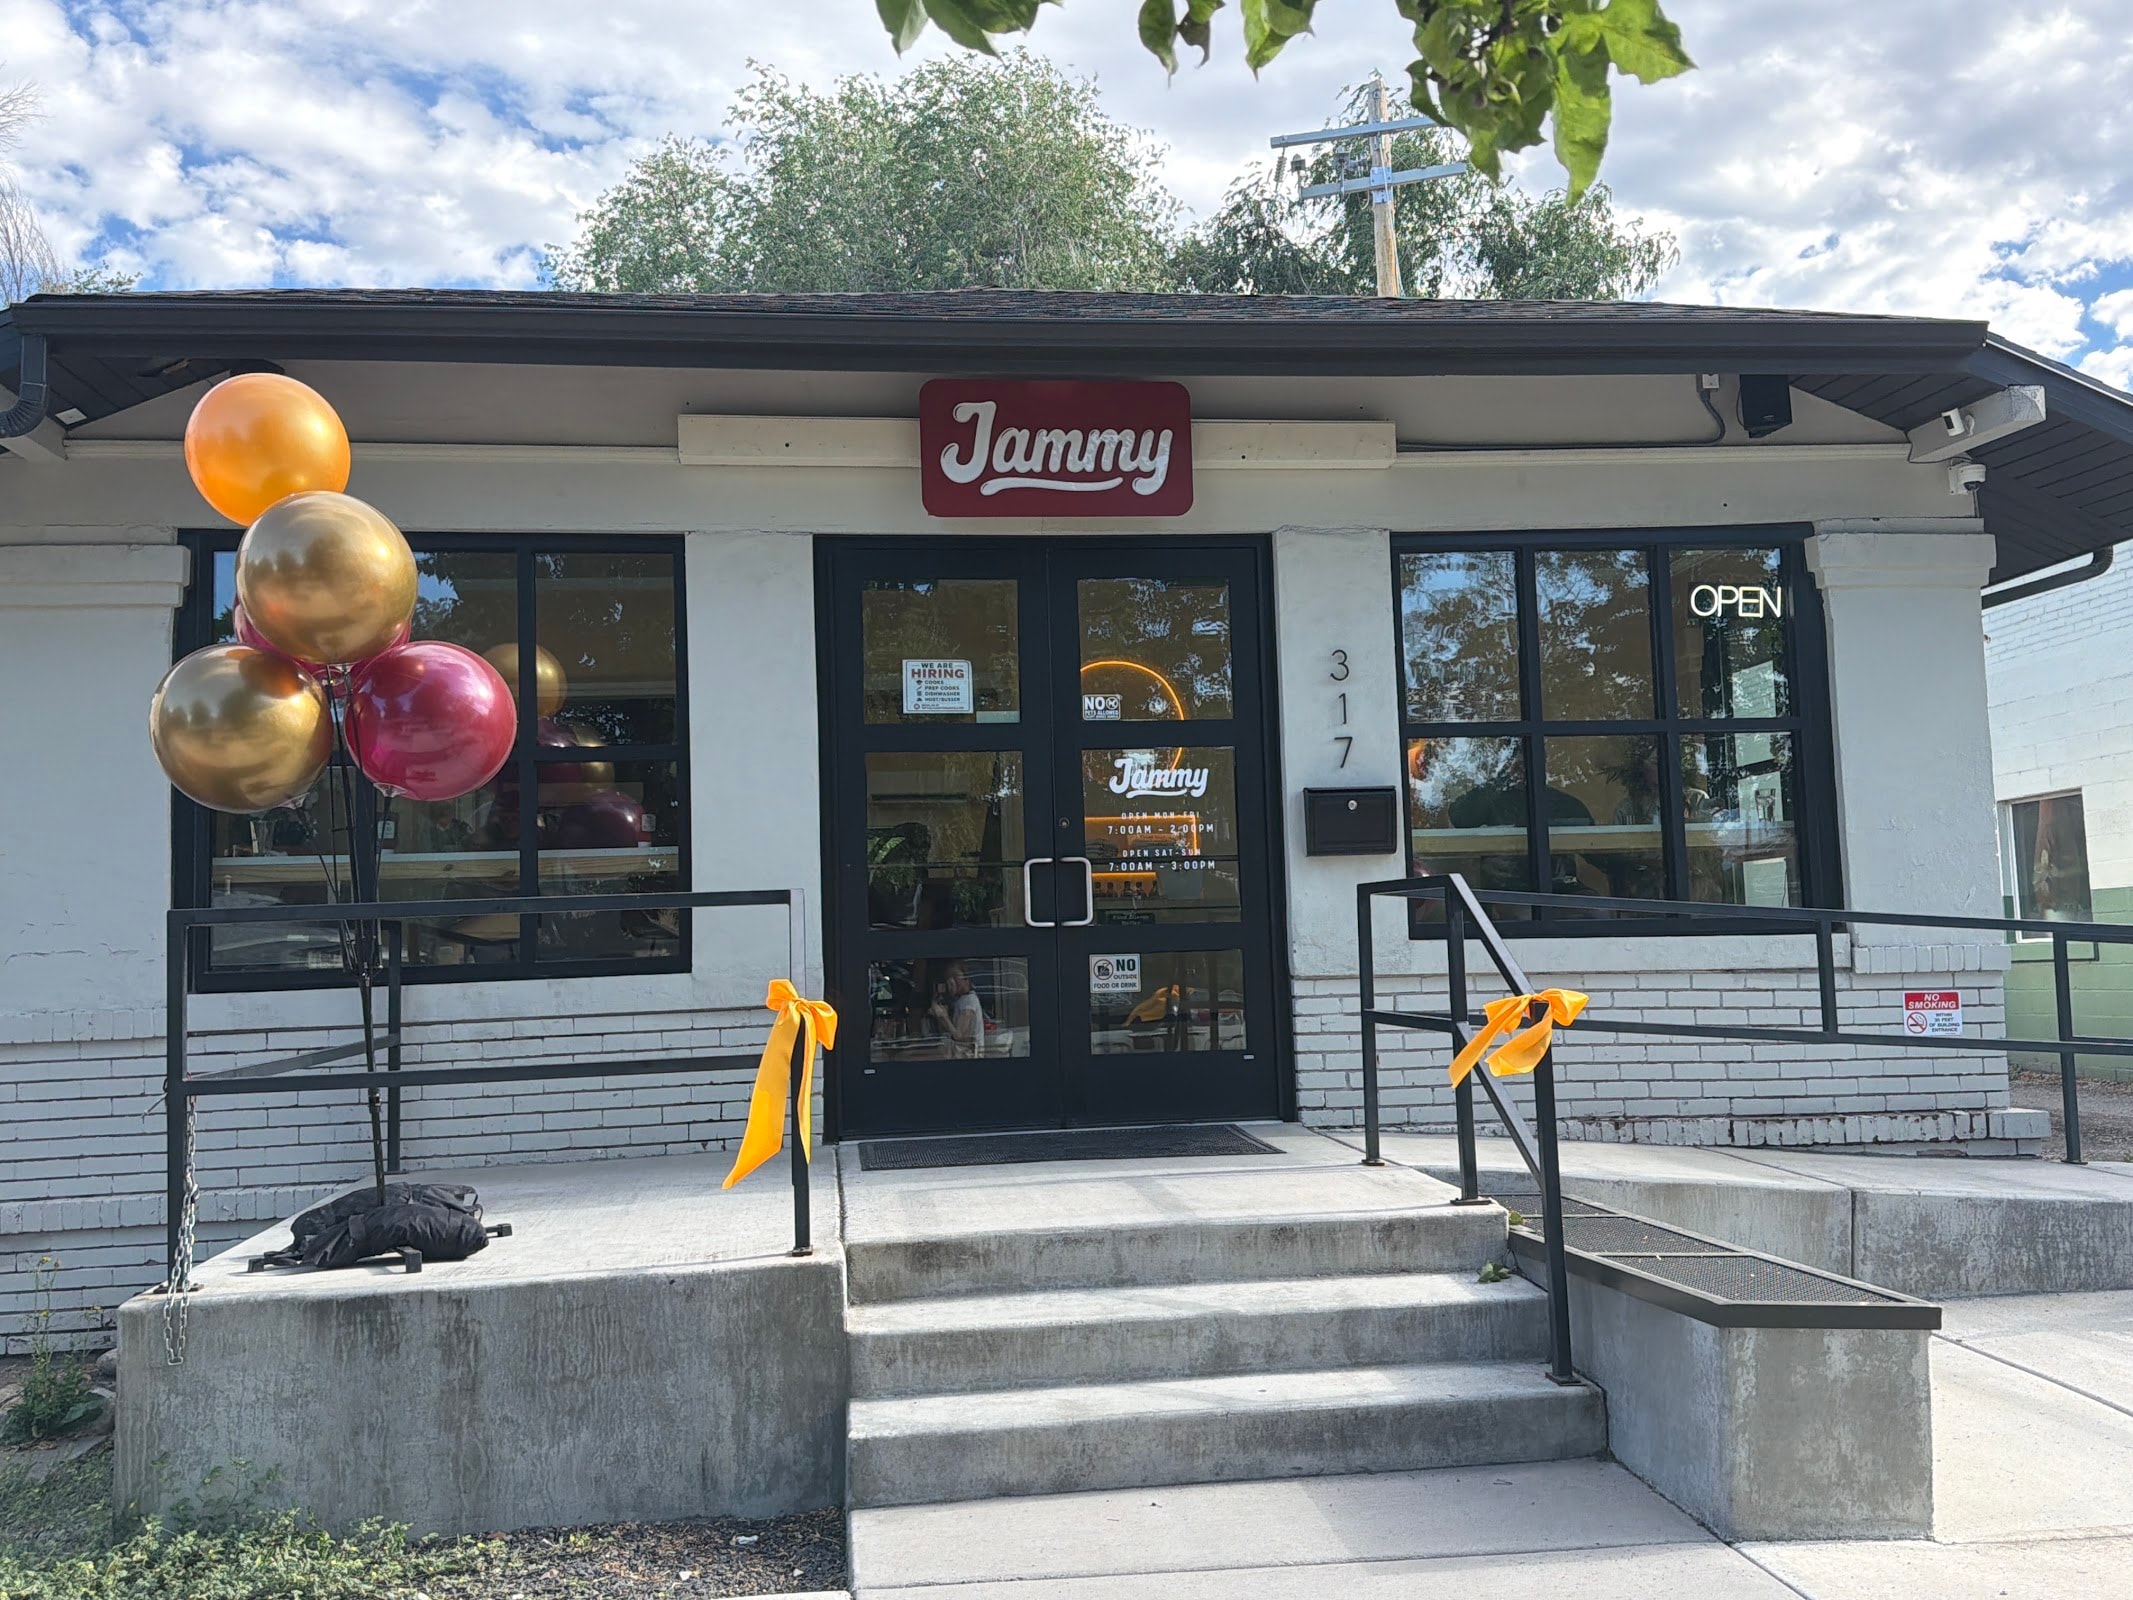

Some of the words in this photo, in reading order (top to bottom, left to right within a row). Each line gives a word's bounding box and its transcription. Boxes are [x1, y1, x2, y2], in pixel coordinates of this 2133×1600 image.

[940, 400, 1174, 496] Jammy
[1690, 584, 1782, 619] OPEN
[911, 668, 965, 679] HIRING
[1084, 696, 1106, 710] NO
[1108, 758, 1209, 799] Jammy
[1121, 812, 1148, 820] OPEN
[1107, 825, 1152, 835] 7:00AM
[1169, 823, 1214, 834] 2:00PM
[1122, 849, 1149, 858] OPEN
[1154, 848, 1201, 857] SAT-SUN
[1108, 862, 1153, 872] 7:00AM
[1171, 860, 1216, 871] 3:00PM
[1115, 959, 1136, 972] NO
[1924, 993, 1940, 1001] NO
[1908, 1000, 1956, 1009] SMOKING
